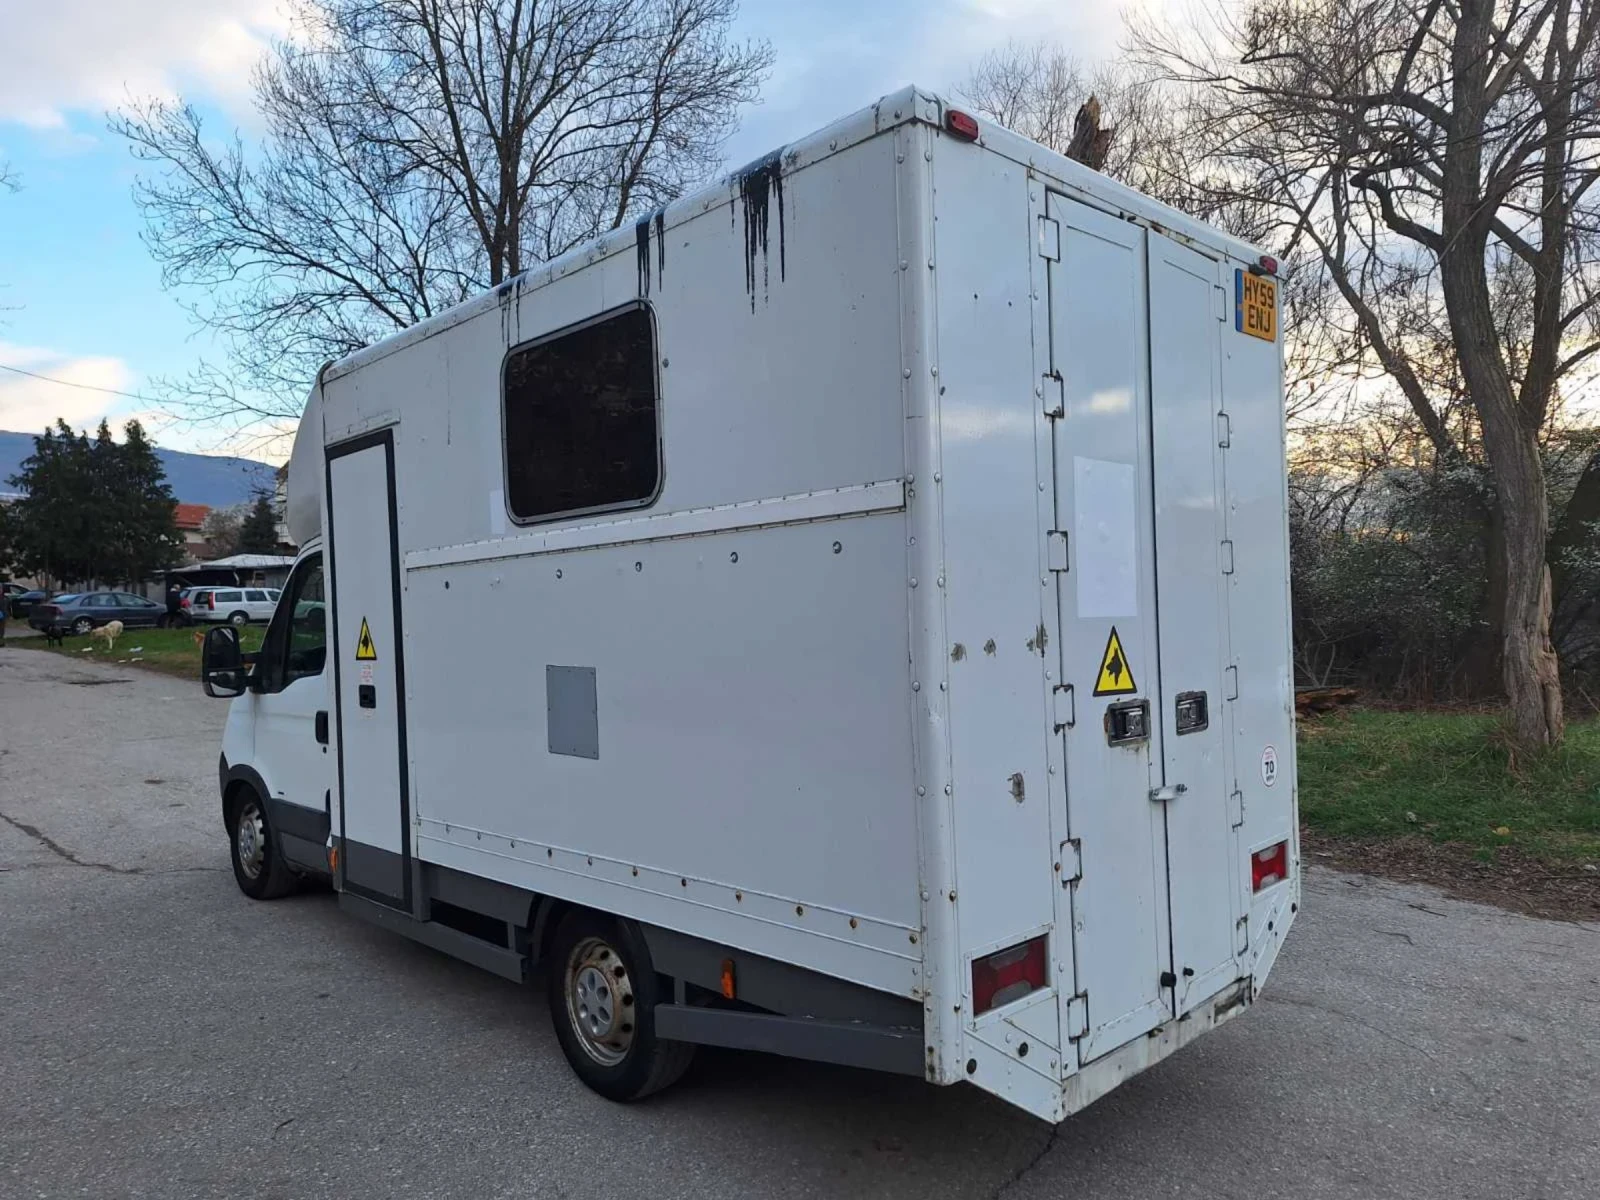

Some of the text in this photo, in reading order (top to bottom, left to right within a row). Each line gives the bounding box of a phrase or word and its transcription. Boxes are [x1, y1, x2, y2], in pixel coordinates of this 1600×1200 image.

[1244, 278, 1274, 309] HY59
[1248, 304, 1270, 332] ENJ
[1264, 760, 1274, 774] 70
